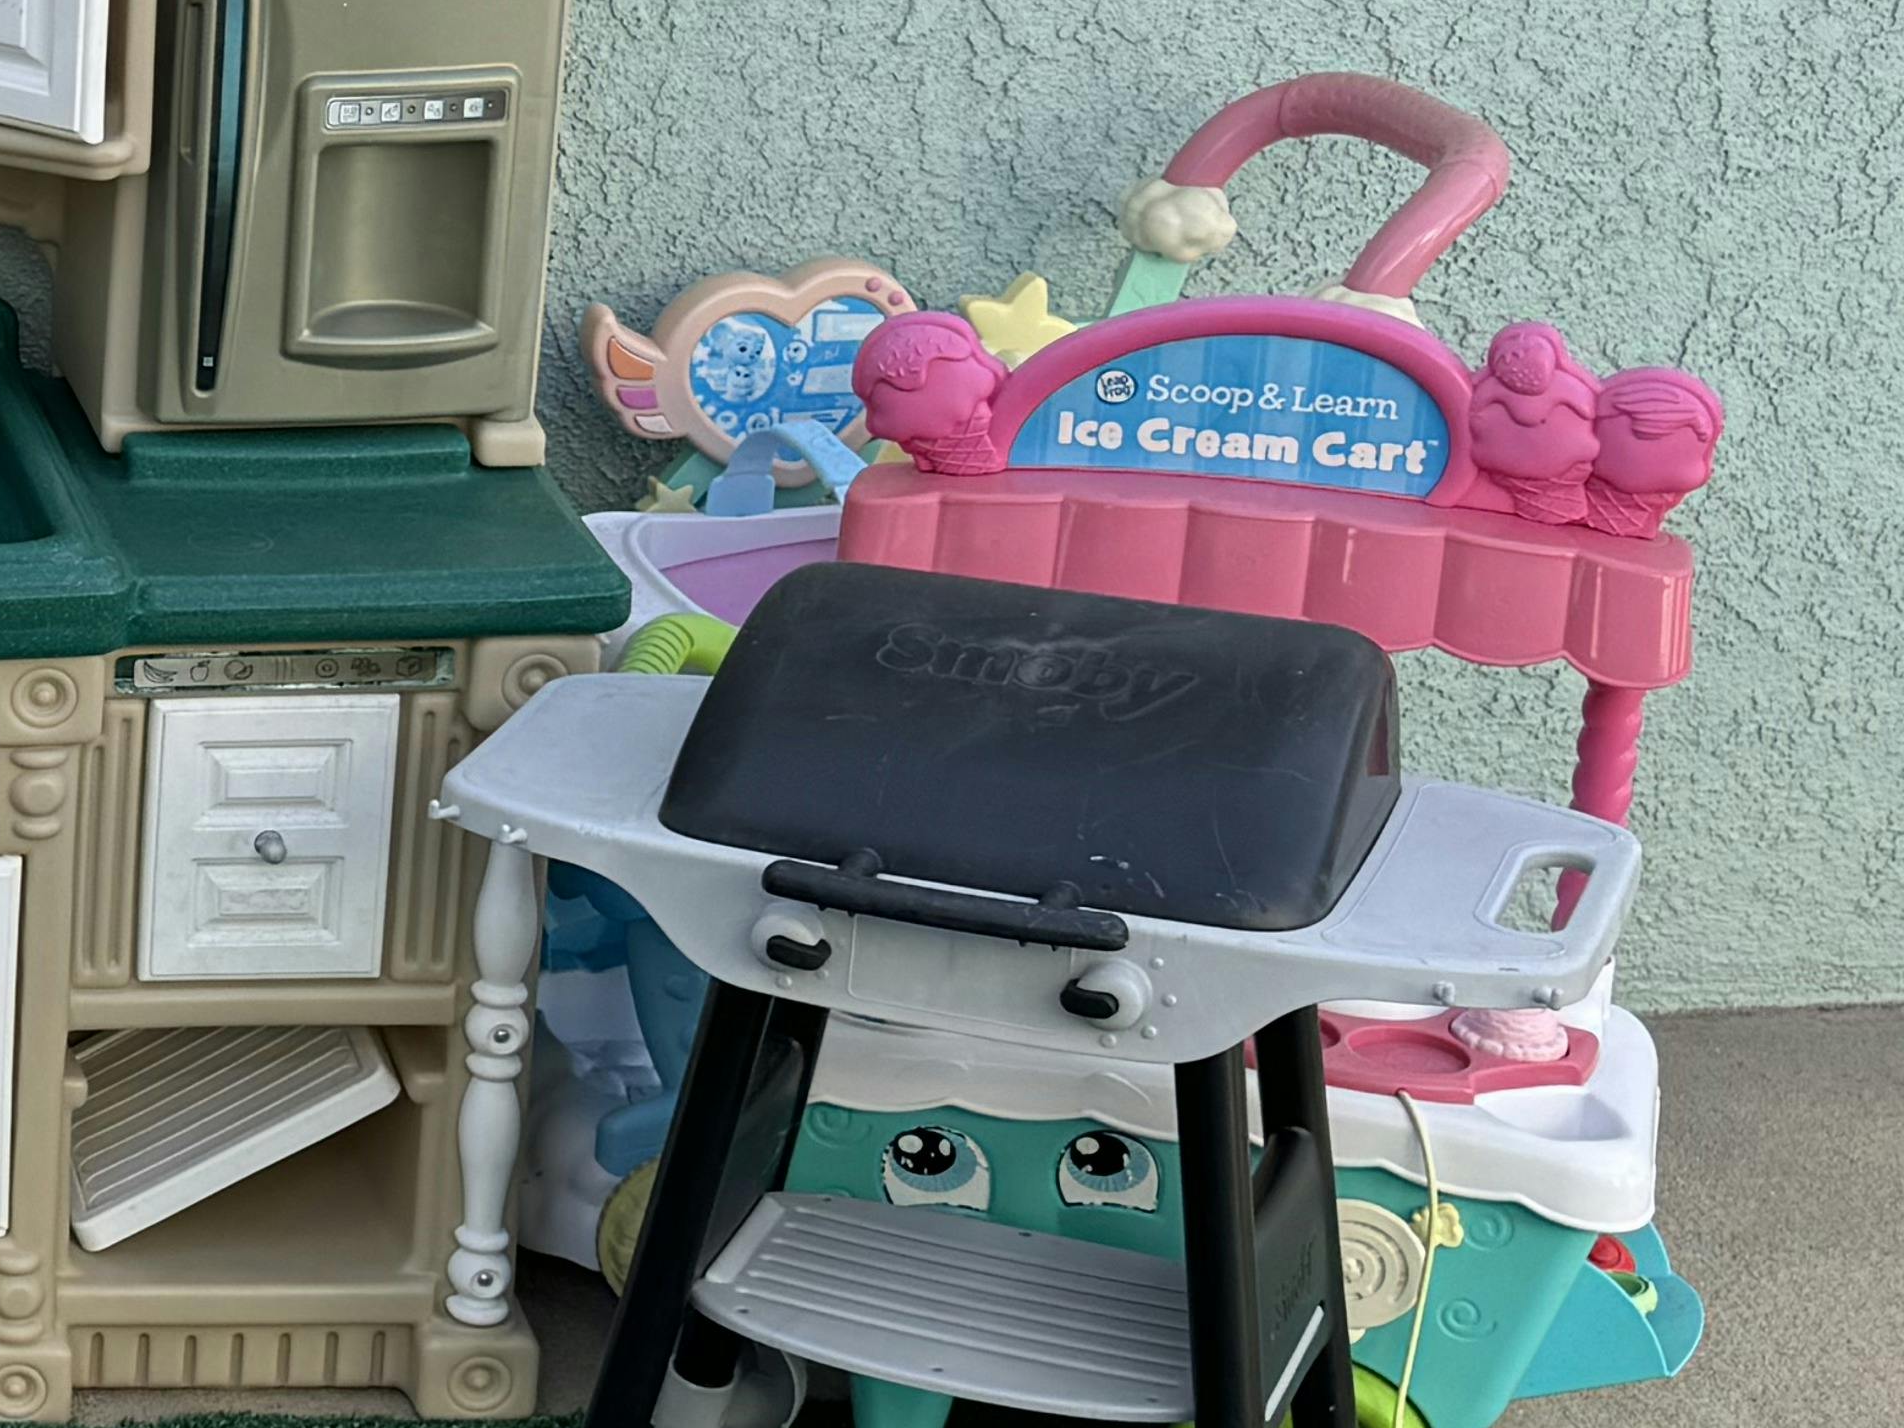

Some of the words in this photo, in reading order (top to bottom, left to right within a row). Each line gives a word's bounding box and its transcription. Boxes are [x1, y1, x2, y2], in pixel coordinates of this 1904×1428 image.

[1146, 374, 1254, 414] Scoop
[1258, 383, 1286, 410] &
[1292, 385, 1399, 420] Learn
[1058, 410, 1124, 450] Ice
[1136, 417, 1300, 464] Cream
